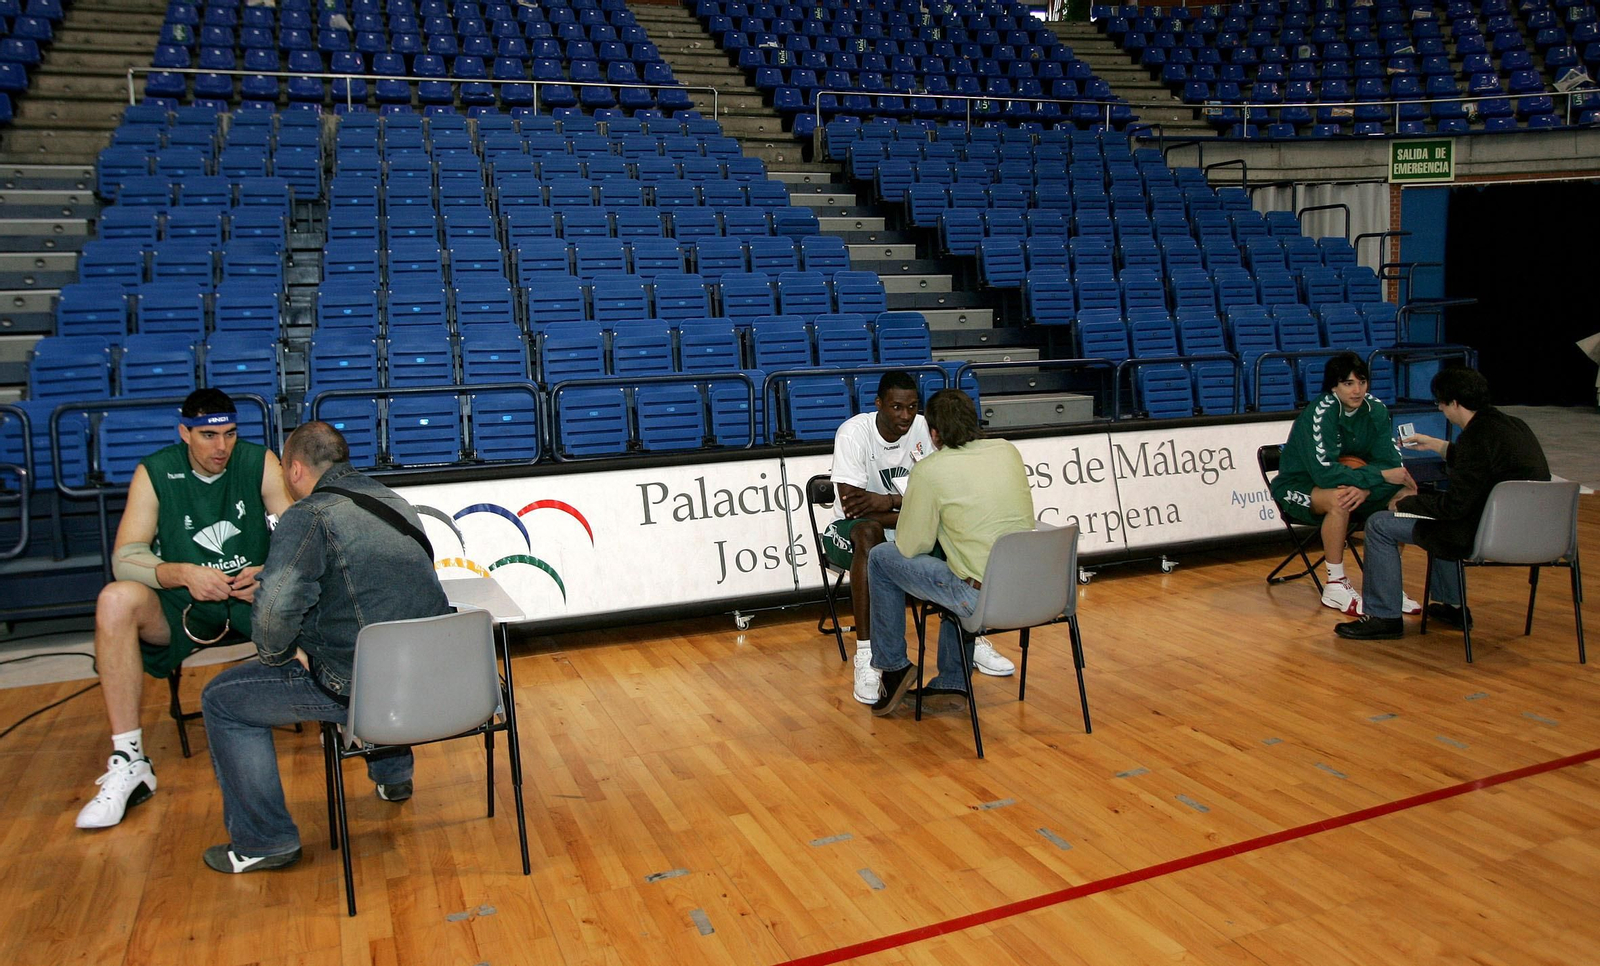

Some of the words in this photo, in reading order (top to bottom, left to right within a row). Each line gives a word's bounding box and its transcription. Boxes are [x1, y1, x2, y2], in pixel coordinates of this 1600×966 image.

[1397, 148, 1429, 161] SALIDA
[1435, 147, 1447, 159] DE
[1393, 161, 1449, 175] EMERGENCIA
[636, 473, 804, 526] Palacio
[1062, 447, 1105, 486] de
[1112, 439, 1236, 485] Málaga
[1231, 488, 1272, 509] Ayunt
[1259, 505, 1275, 521] de
[714, 534, 807, 585] José
[1037, 503, 1182, 544] Carpena
